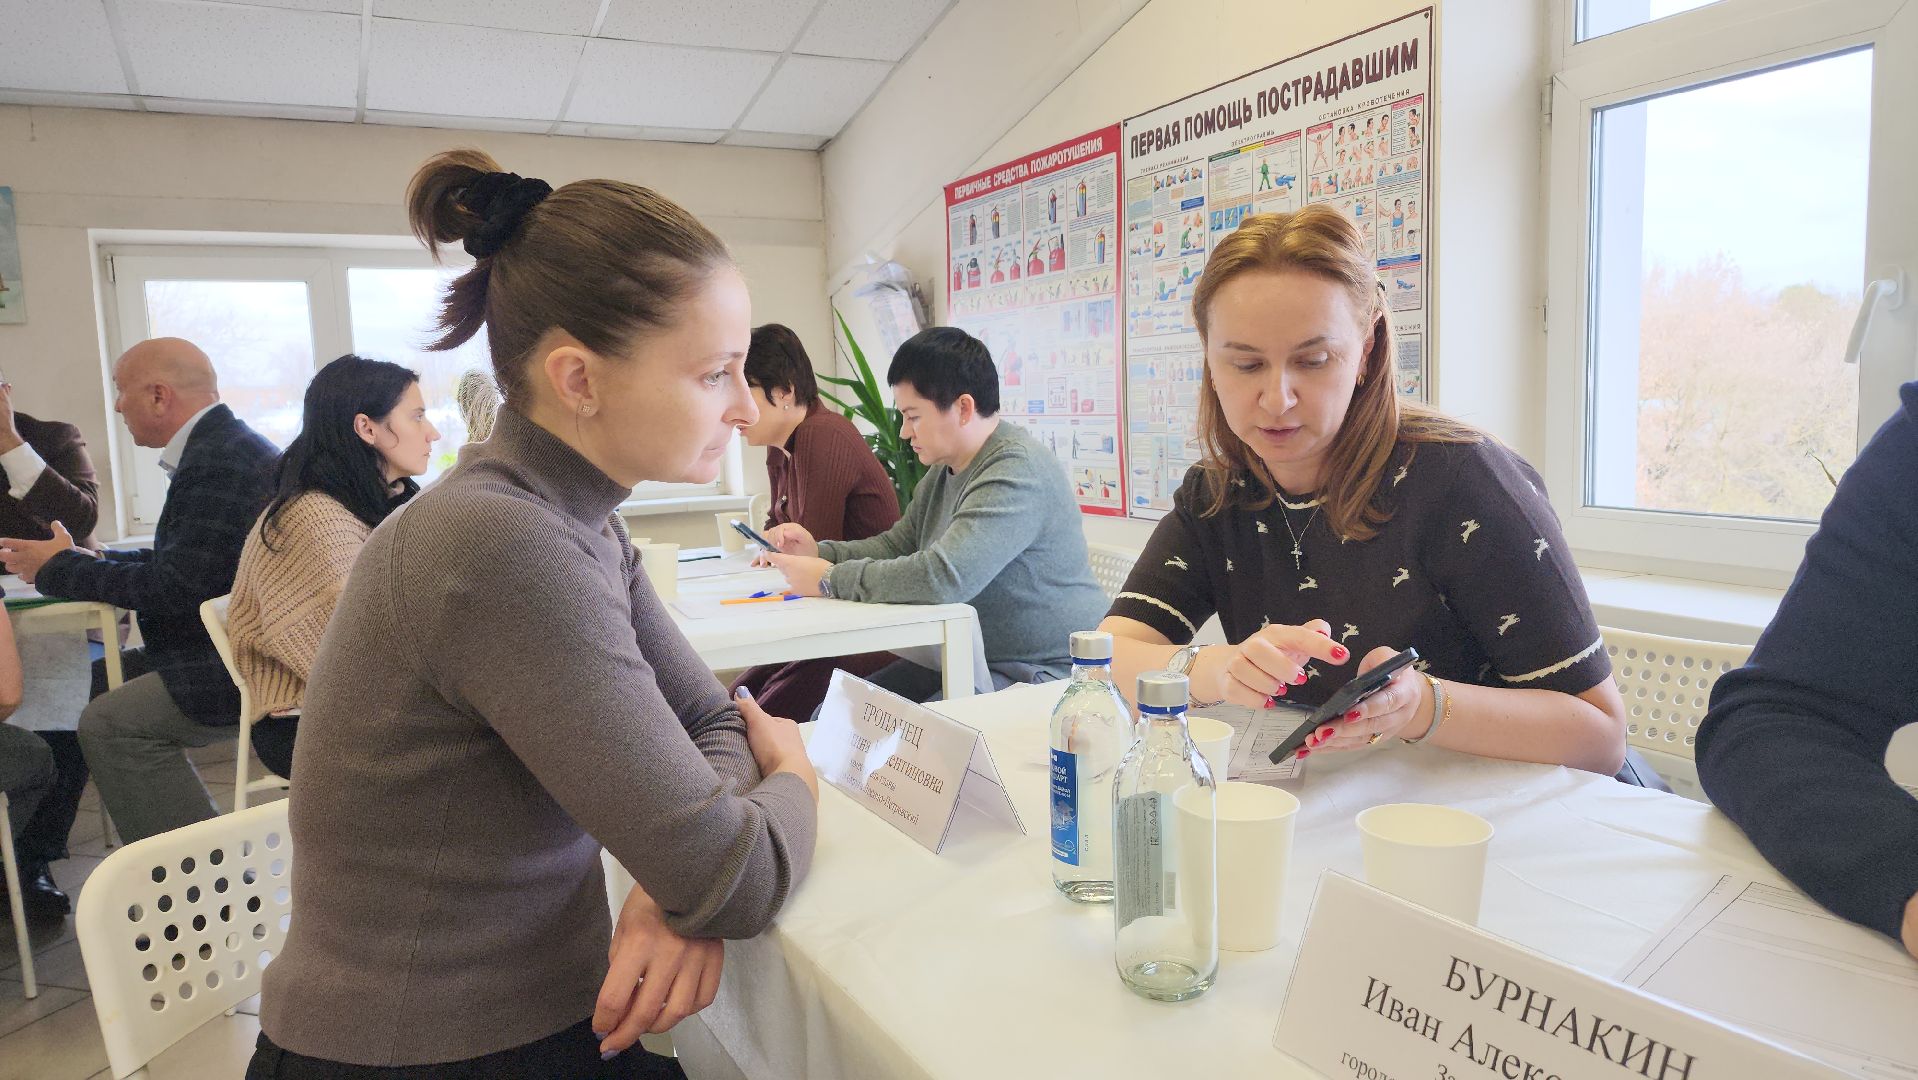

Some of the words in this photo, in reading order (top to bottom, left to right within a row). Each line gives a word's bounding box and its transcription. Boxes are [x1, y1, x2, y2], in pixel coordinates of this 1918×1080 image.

[1130, 120, 1181, 160] ПЕРВАЯ
[1184, 97, 1253, 142] ПОМОЩЬ
[1257, 37, 1419, 119] ПОСТРАДАВШИМ
[1318, 106, 1354, 121] ОСТАНОВКА
[1357, 88, 1410, 110] КРОВОТЕЧЕНИЯ
[954, 175, 992, 200] ПЕРВИЧНЫЕ
[993, 163, 1029, 186] СРЕДСТВА
[1030, 136, 1103, 174] ПОЖАРОТУШЕНИЯ
[1360, 975, 1443, 1043] Иван
[1449, 1023, 1563, 1080] Алек
[1441, 954, 1698, 1080] БУРНАКИН
